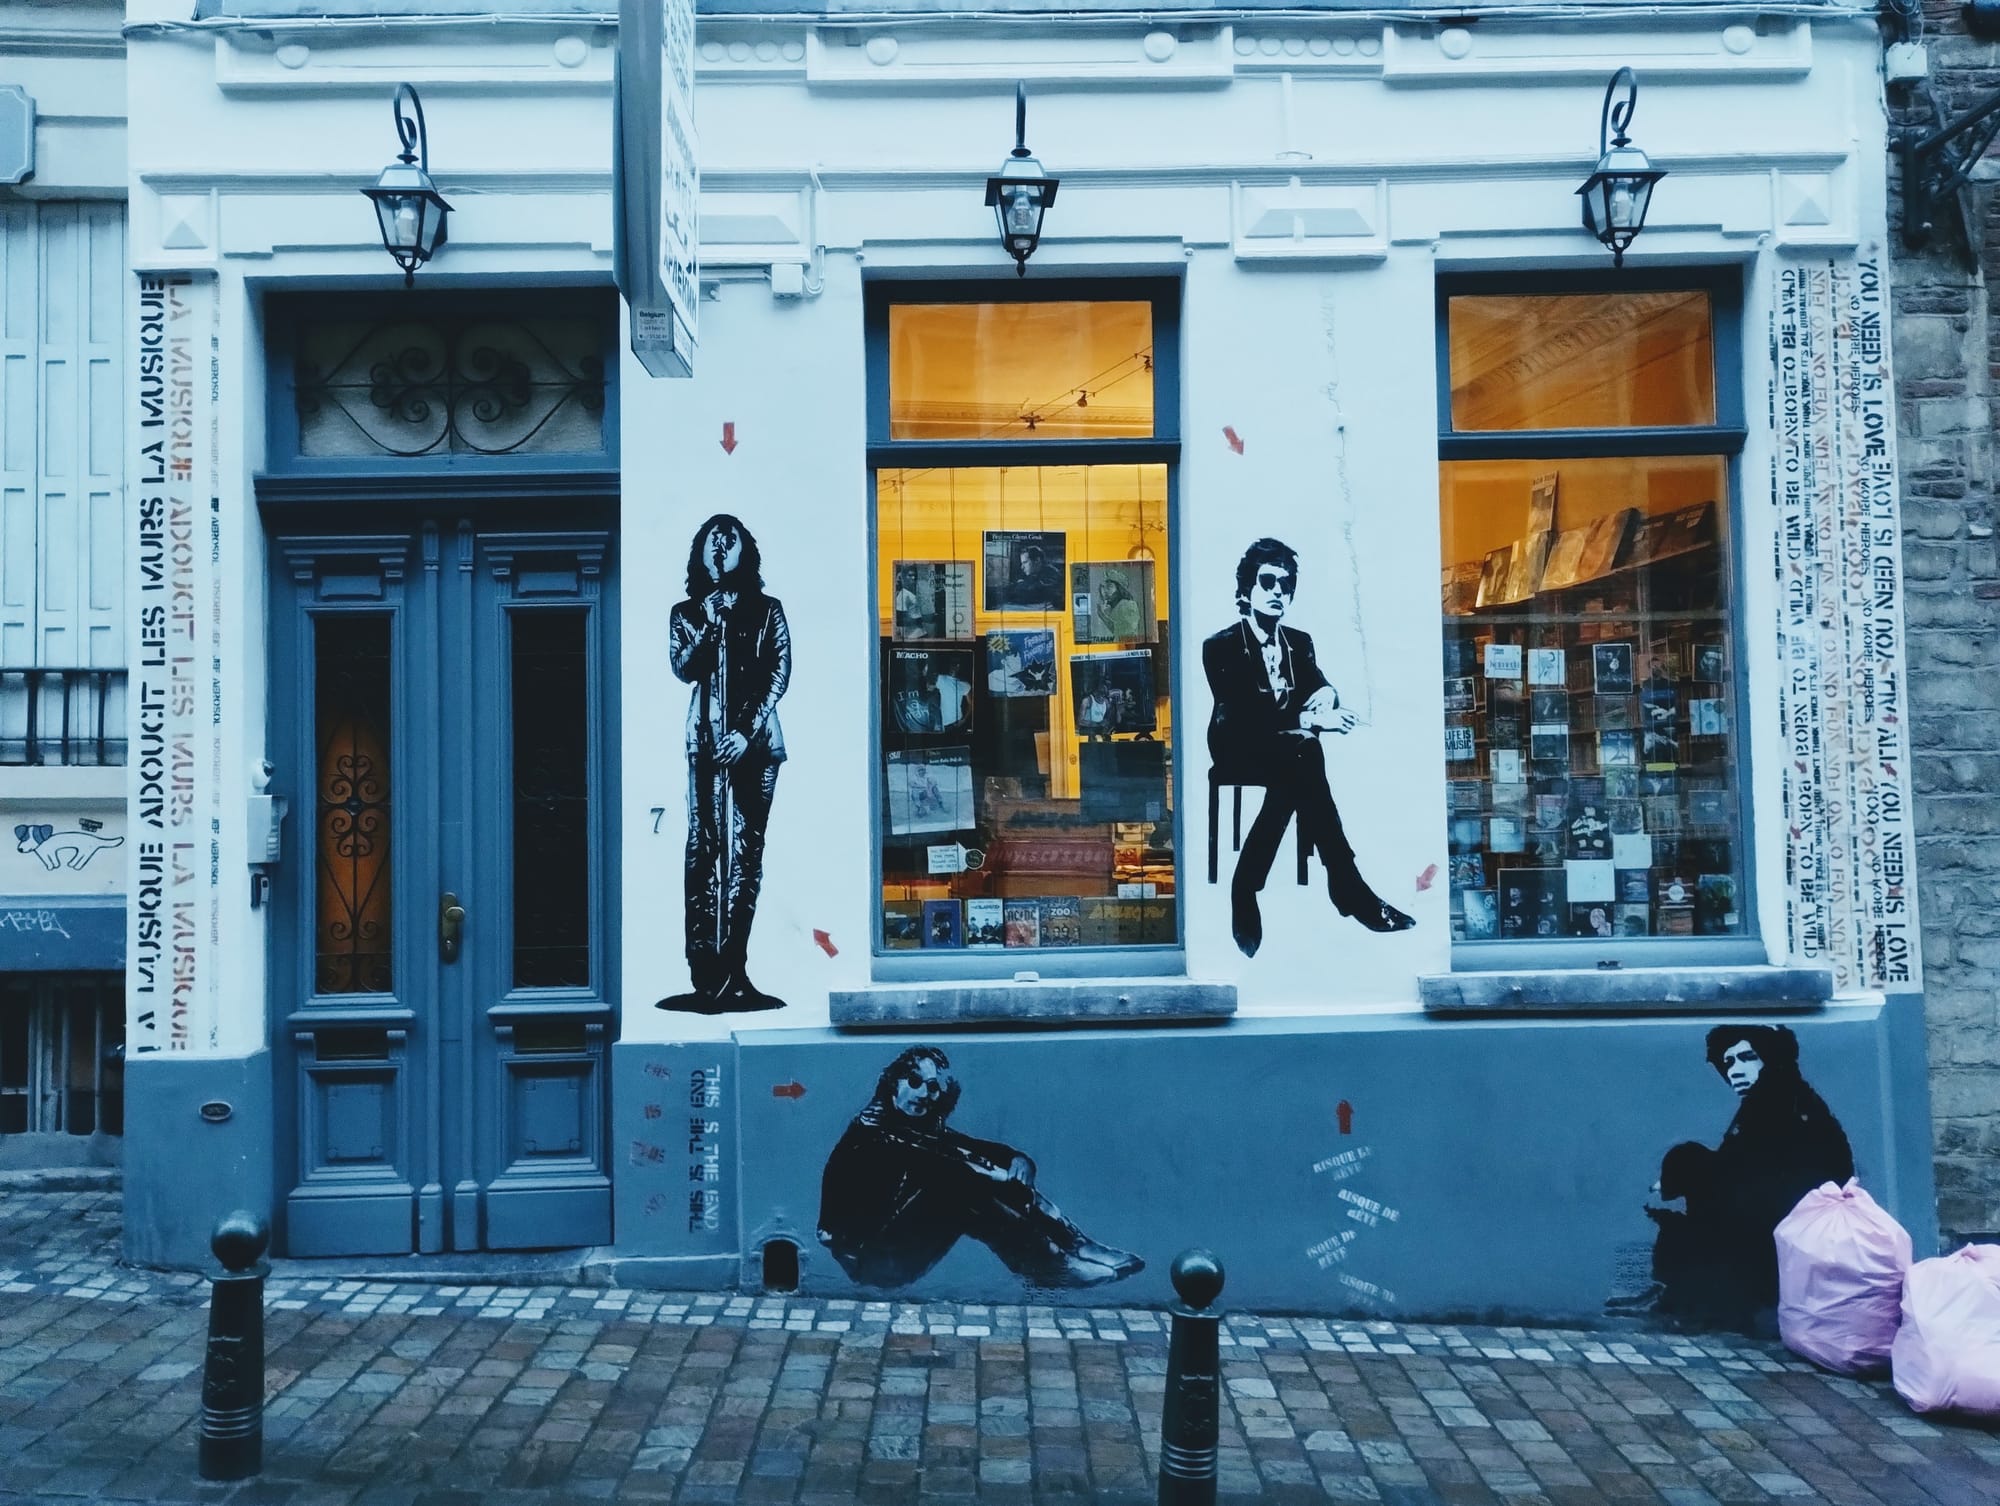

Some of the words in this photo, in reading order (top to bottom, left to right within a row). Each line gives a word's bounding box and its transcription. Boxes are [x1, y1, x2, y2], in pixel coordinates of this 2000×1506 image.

[170, 277, 192, 321] LA
[1858, 258, 1879, 302] YOU
[140, 277, 164, 427] MUSIQUE
[1782, 324, 1796, 349] BE
[1850, 316, 1861, 355] MORE
[1861, 311, 1882, 364] NEED
[1850, 360, 1861, 413] HEROES
[1863, 373, 1882, 390] IS
[169, 337, 192, 482] MUSIQUE
[1783, 385, 1798, 436] BORN
[1862, 399, 1886, 455] LOVE
[141, 441, 164, 484] LA
[1785, 445, 1799, 472] TO
[1785, 480, 1799, 506] BE
[1860, 478, 1870, 516] MORE
[1872, 462, 1892, 519] LOVE
[140, 497, 164, 591] MURS
[1786, 515, 1801, 560] WILD
[1861, 522, 1871, 575] HEROES
[1874, 529, 1893, 547] IS
[170, 496, 194, 641] ADOUCIT
[1874, 556, 1894, 609] NEED
[1788, 579, 1804, 625] WILD
[141, 606, 165, 666] LES
[1791, 635, 1806, 660] BE
[1874, 618, 1895, 663] YOU
[171, 657, 194, 717] LES
[212, 678, 221, 727] AEROSOL
[1792, 668, 1807, 695] TO
[1864, 668, 1874, 722] HEROES
[1444, 740, 1471, 750] MUSIC
[1462, 730, 1471, 739] IS
[1794, 704, 1809, 756] BORN
[138, 681, 164, 828] ADOUCIT
[171, 733, 194, 827] MURS
[650, 807, 666, 834] 7
[1798, 780, 1813, 833] BORN
[172, 842, 195, 887] LA
[211, 838, 220, 888] AEROSOL
[1800, 842, 1813, 870] TO
[1882, 832, 1904, 885] NEED
[1051, 908, 1071, 916] ZOO
[1801, 878, 1815, 903] BE
[1872, 879, 1883, 919] MORE
[1801, 912, 1817, 959] WILD
[1885, 923, 1909, 982] LOVE
[691, 1070, 705, 1108] END
[704, 1064, 720, 1108] THIS
[689, 1118, 705, 1154] THE
[689, 1164, 704, 1182] IS
[703, 1144, 719, 1181] THE
[689, 1190, 704, 1233] THIS
[704, 1190, 720, 1232] END
